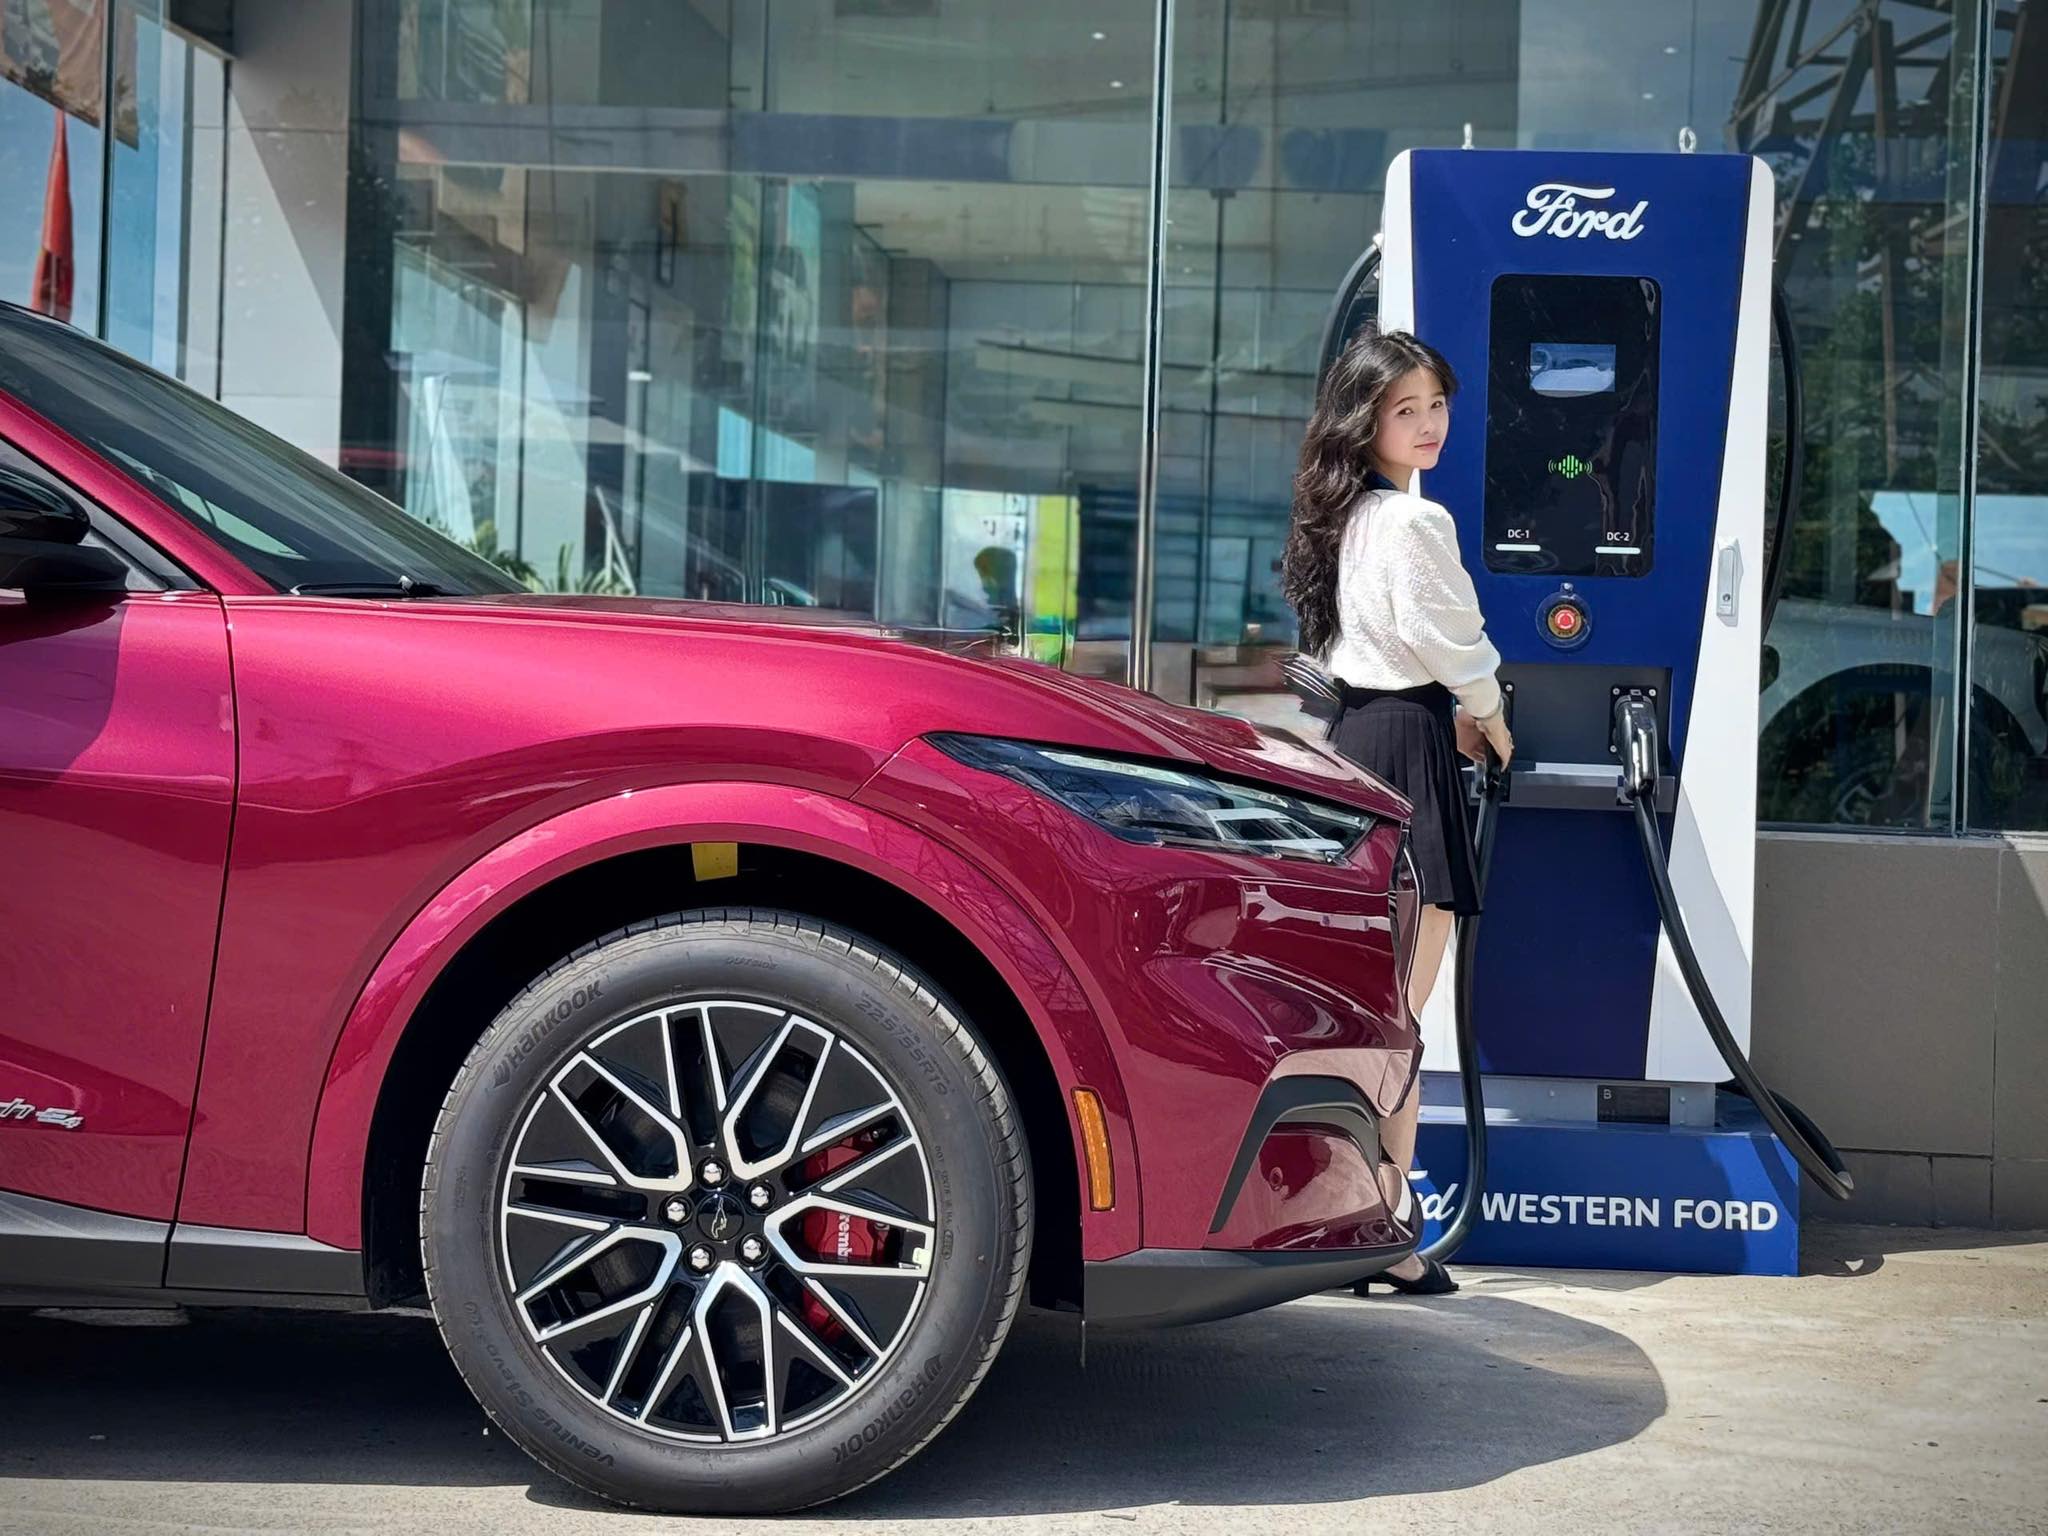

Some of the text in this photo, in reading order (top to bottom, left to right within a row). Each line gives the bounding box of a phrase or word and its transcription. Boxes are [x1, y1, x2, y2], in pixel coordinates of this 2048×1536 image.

[1512, 183, 1648, 239] Ford
[1507, 528, 1530, 539] DC-1
[1606, 531, 1630, 541] DC-2
[1481, 1191, 1660, 1228] WESTERN
[1674, 1199, 1778, 1231] FORD
